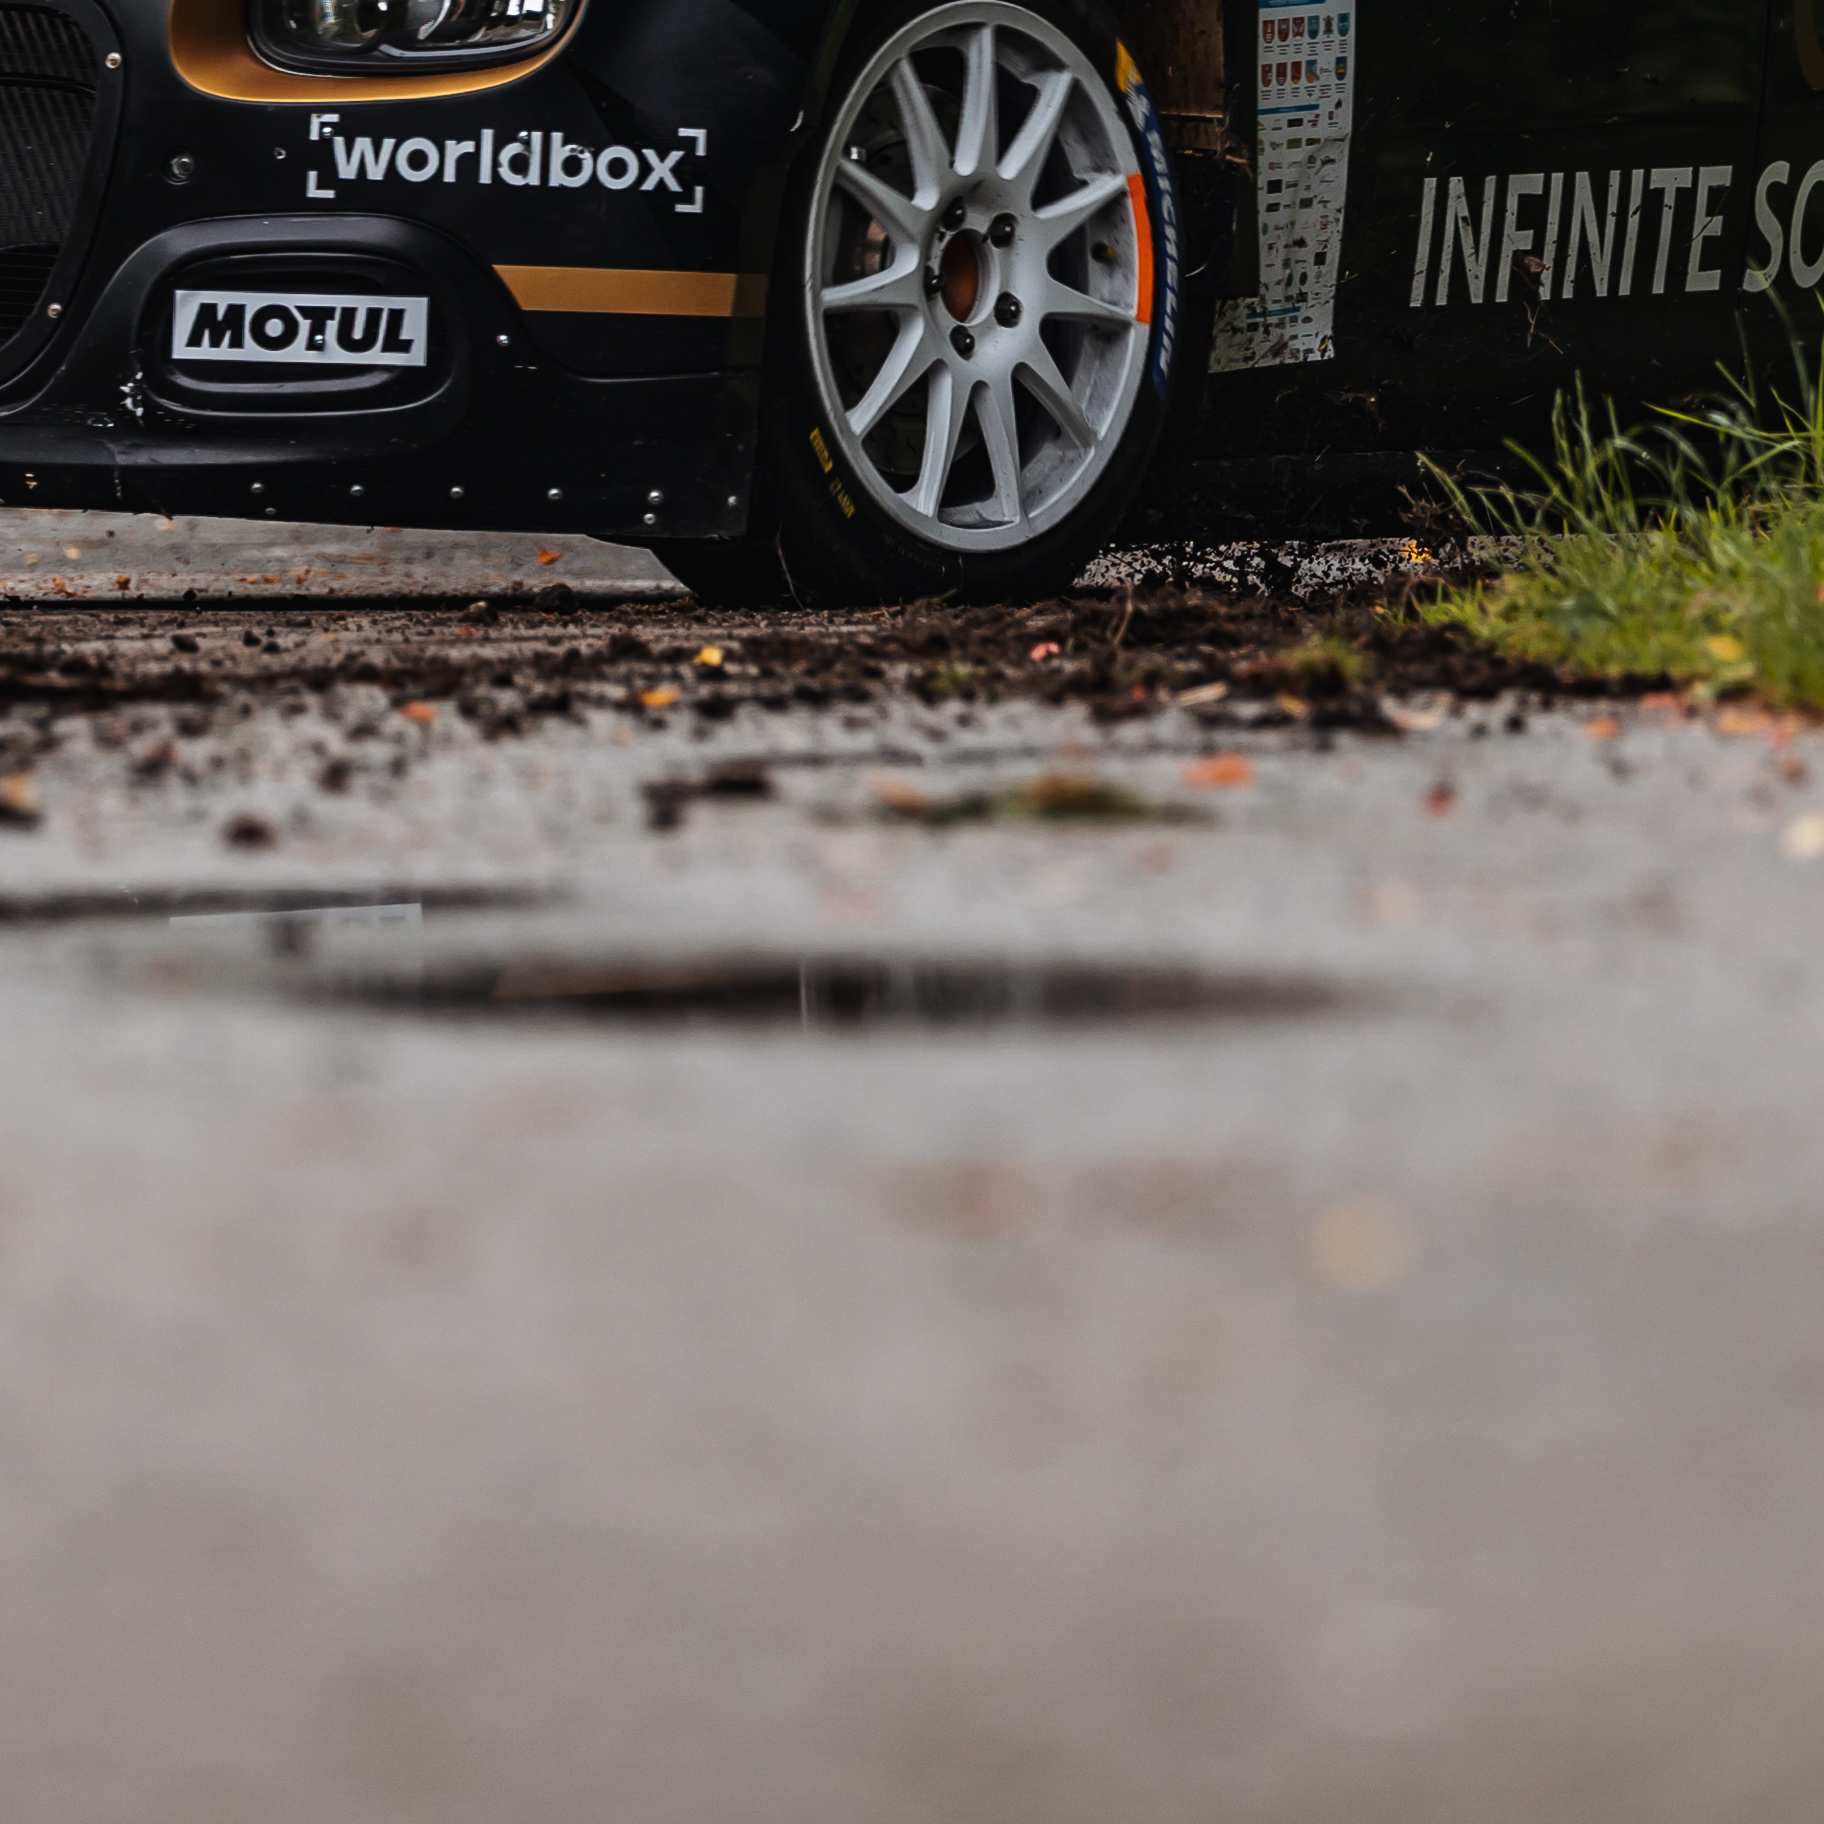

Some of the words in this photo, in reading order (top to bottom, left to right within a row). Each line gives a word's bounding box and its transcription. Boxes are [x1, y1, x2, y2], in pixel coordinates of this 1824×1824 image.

[332, 127, 685, 193] worldbox
[1408, 164, 1733, 308] INFINITE
[184, 301, 417, 355] MOTUL
